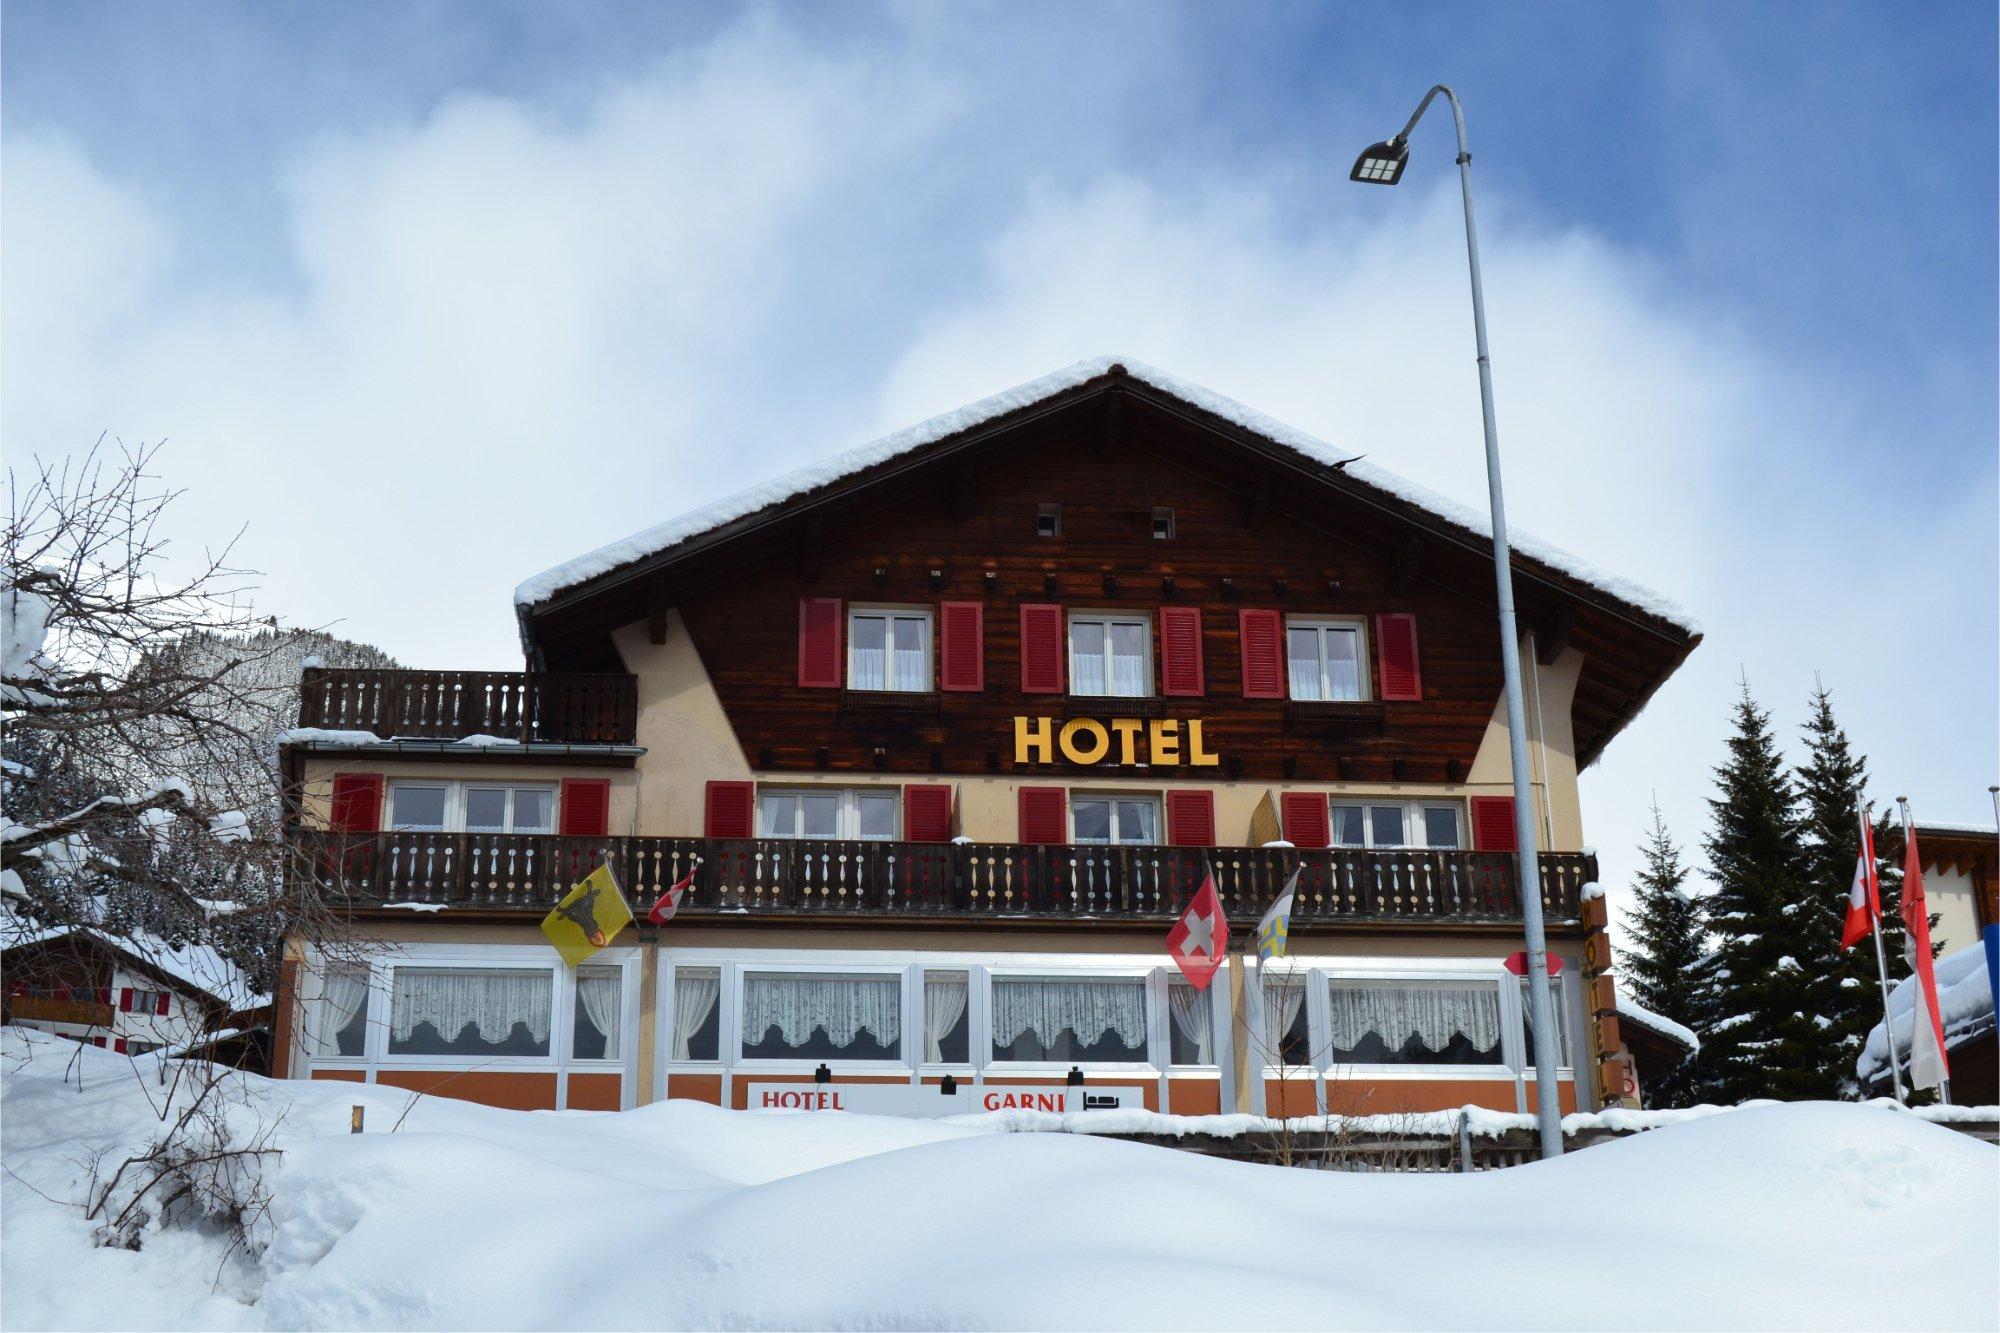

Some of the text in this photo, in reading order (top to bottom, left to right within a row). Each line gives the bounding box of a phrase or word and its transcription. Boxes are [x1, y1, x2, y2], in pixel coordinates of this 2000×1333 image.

[1014, 717, 1219, 766] HOTEL
[1582, 896, 1612, 1099] HOTEL
[762, 1091, 1065, 1113] HOTEL GARNI
